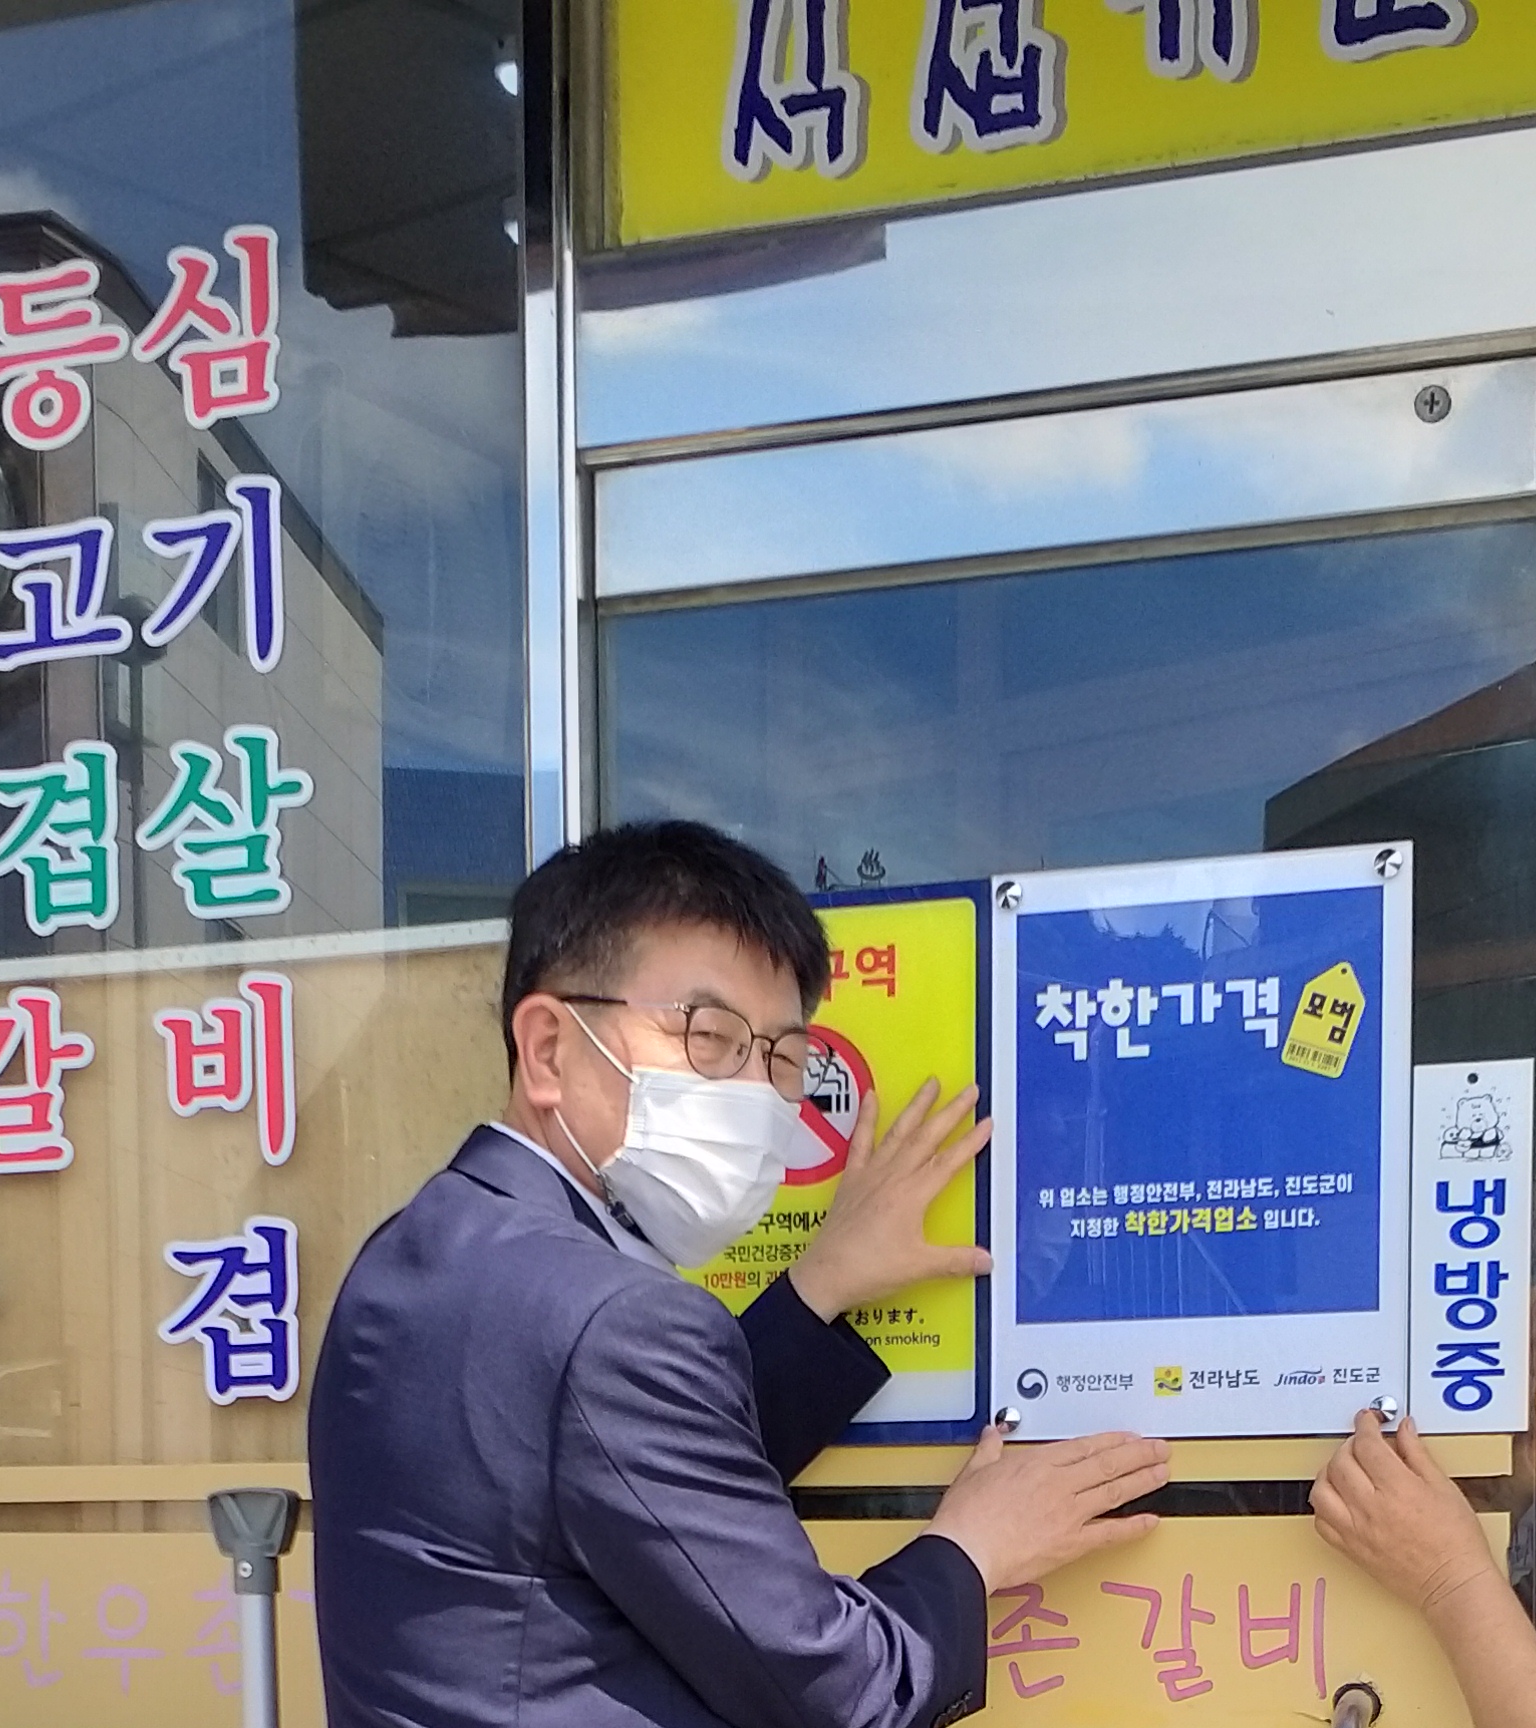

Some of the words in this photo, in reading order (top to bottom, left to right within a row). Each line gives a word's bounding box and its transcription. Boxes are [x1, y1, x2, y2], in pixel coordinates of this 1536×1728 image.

[1035, 976, 1280, 1061] 착한가격
[1302, 992, 1356, 1045] 모범
[1039, 1188, 1054, 1208] 위
[1060, 1186, 1109, 1207] 업소는
[1114, 1181, 1202, 1206] 행정안전부,
[1207, 1177, 1280, 1200] 전라남도,
[1284, 1173, 1354, 1196] 진도군이
[1070, 1217, 1119, 1239] 지정한
[1125, 1206, 1258, 1236] 착한가격업소
[1263, 1208, 1320, 1229] 입니다.
[1431, 1178, 1509, 1412] 냉방중
[884, 1332, 941, 1347] smoking
[1056, 1374, 1134, 1393] 행정안전부
[1189, 1369, 1261, 1389] 전라남도
[1332, 1367, 1381, 1384] 진도군
